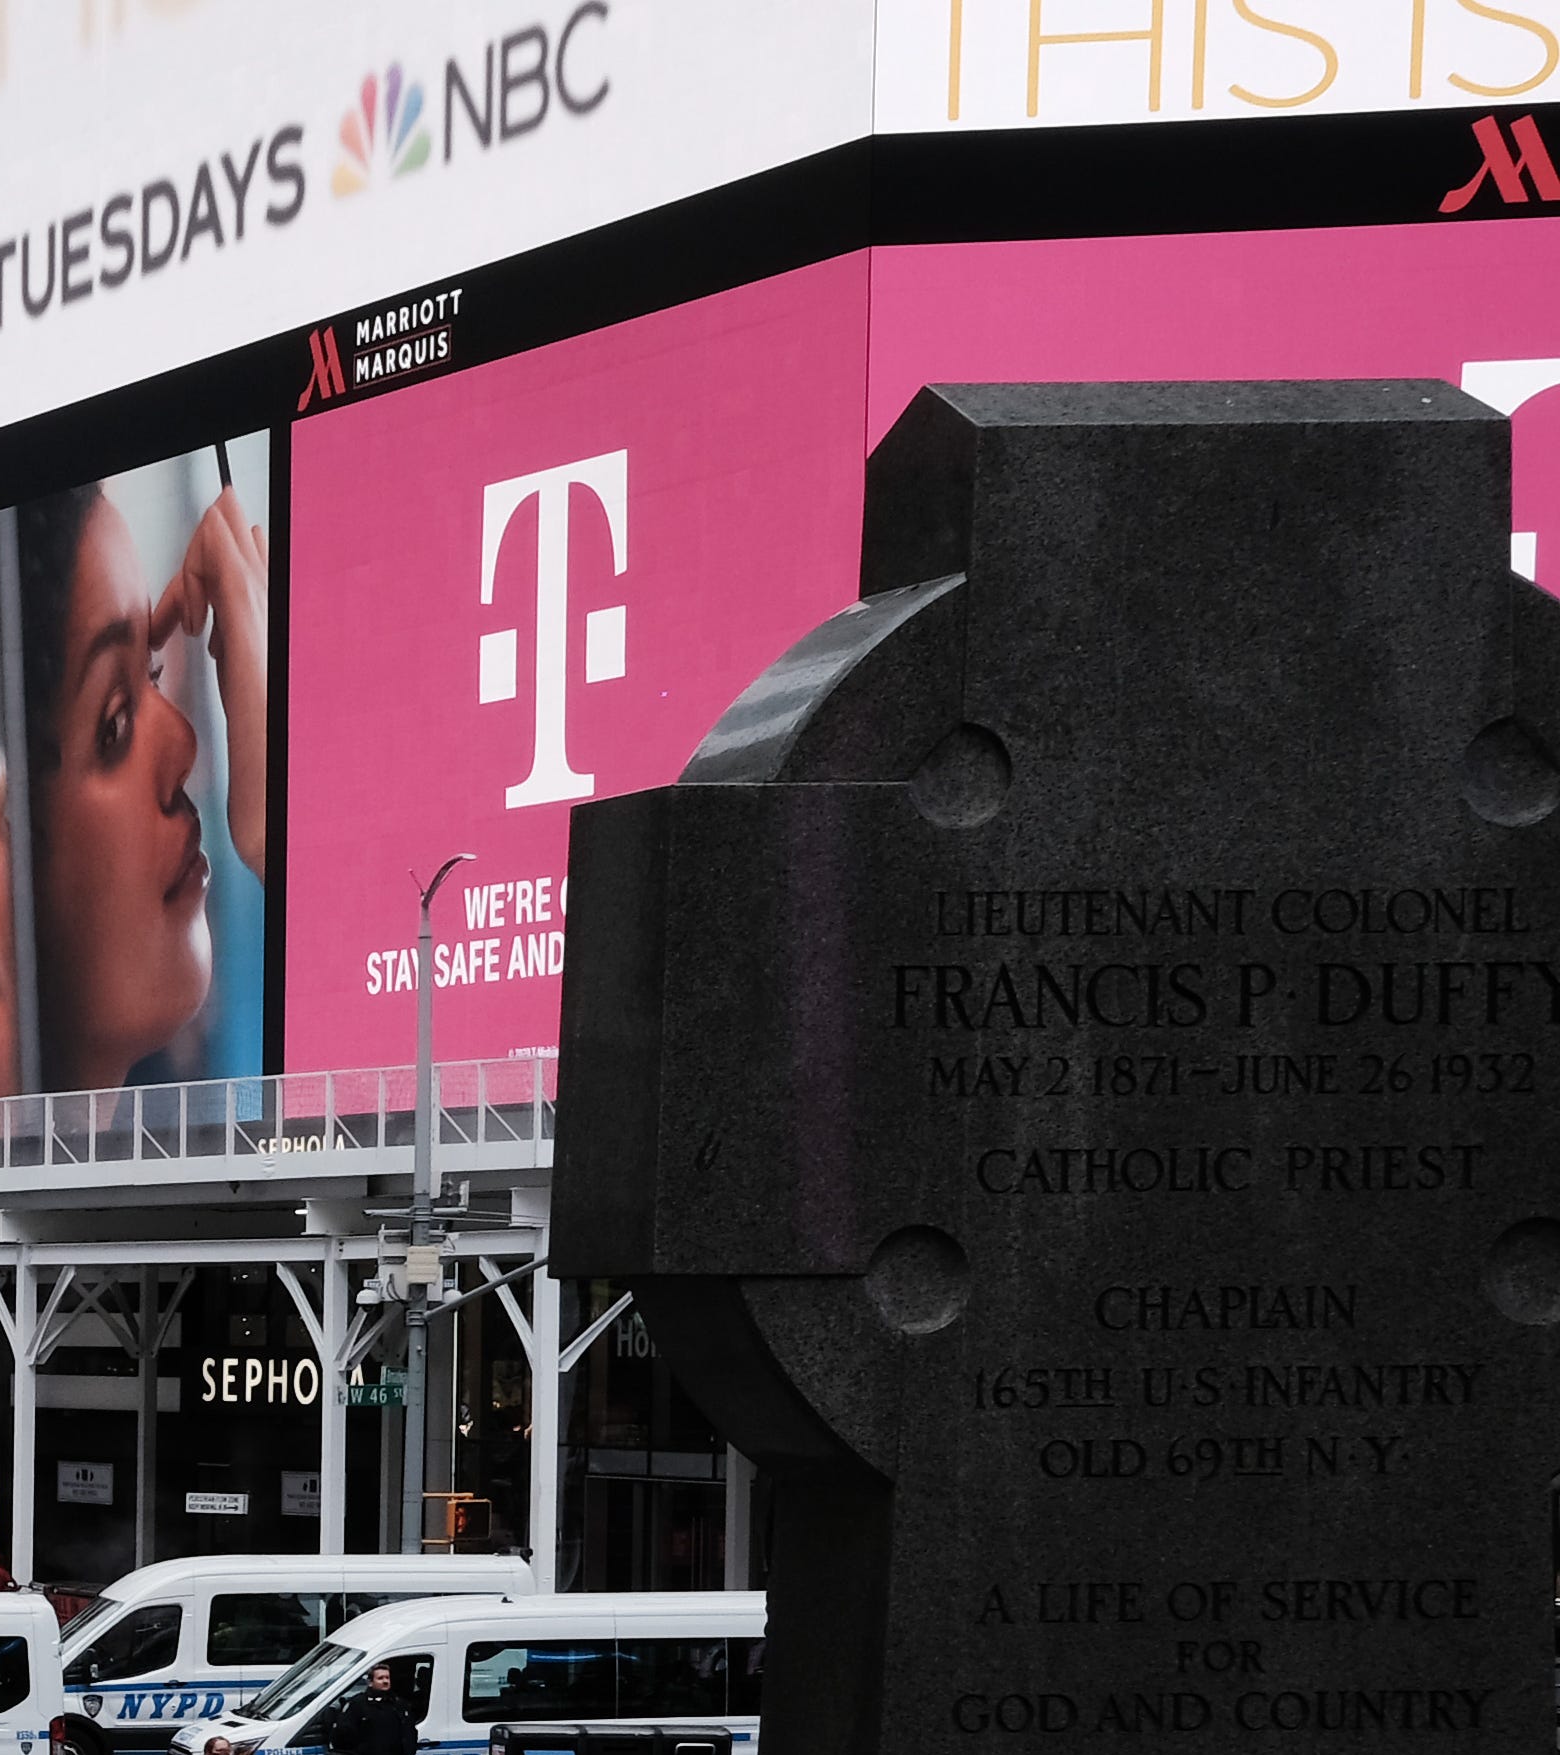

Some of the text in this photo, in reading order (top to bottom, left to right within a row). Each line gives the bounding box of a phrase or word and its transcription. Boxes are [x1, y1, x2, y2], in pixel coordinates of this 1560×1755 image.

[441, 0, 612, 167] NBC
[354, 288, 464, 348] MARRIOTT
[354, 330, 450, 384] MARQUIS
[935, 886, 1531, 938] LIEUTENANT COLONEL
[434, 940, 500, 990] SAFE
[507, 930, 565, 980] AND
[976, 1144, 1484, 1195] CATHOLIC PRIEST
[1094, 1284, 1359, 1332] CHAPLAIN
[201, 1357, 366, 1406] SEPHOA
[977, 1577, 1481, 1626] A LIFE OF SERVICE
[1175, 1639, 1267, 1675] FOR
[116, 1691, 227, 1720] NYPD
[950, 1687, 1497, 1734] GOD AND COUNTRY
